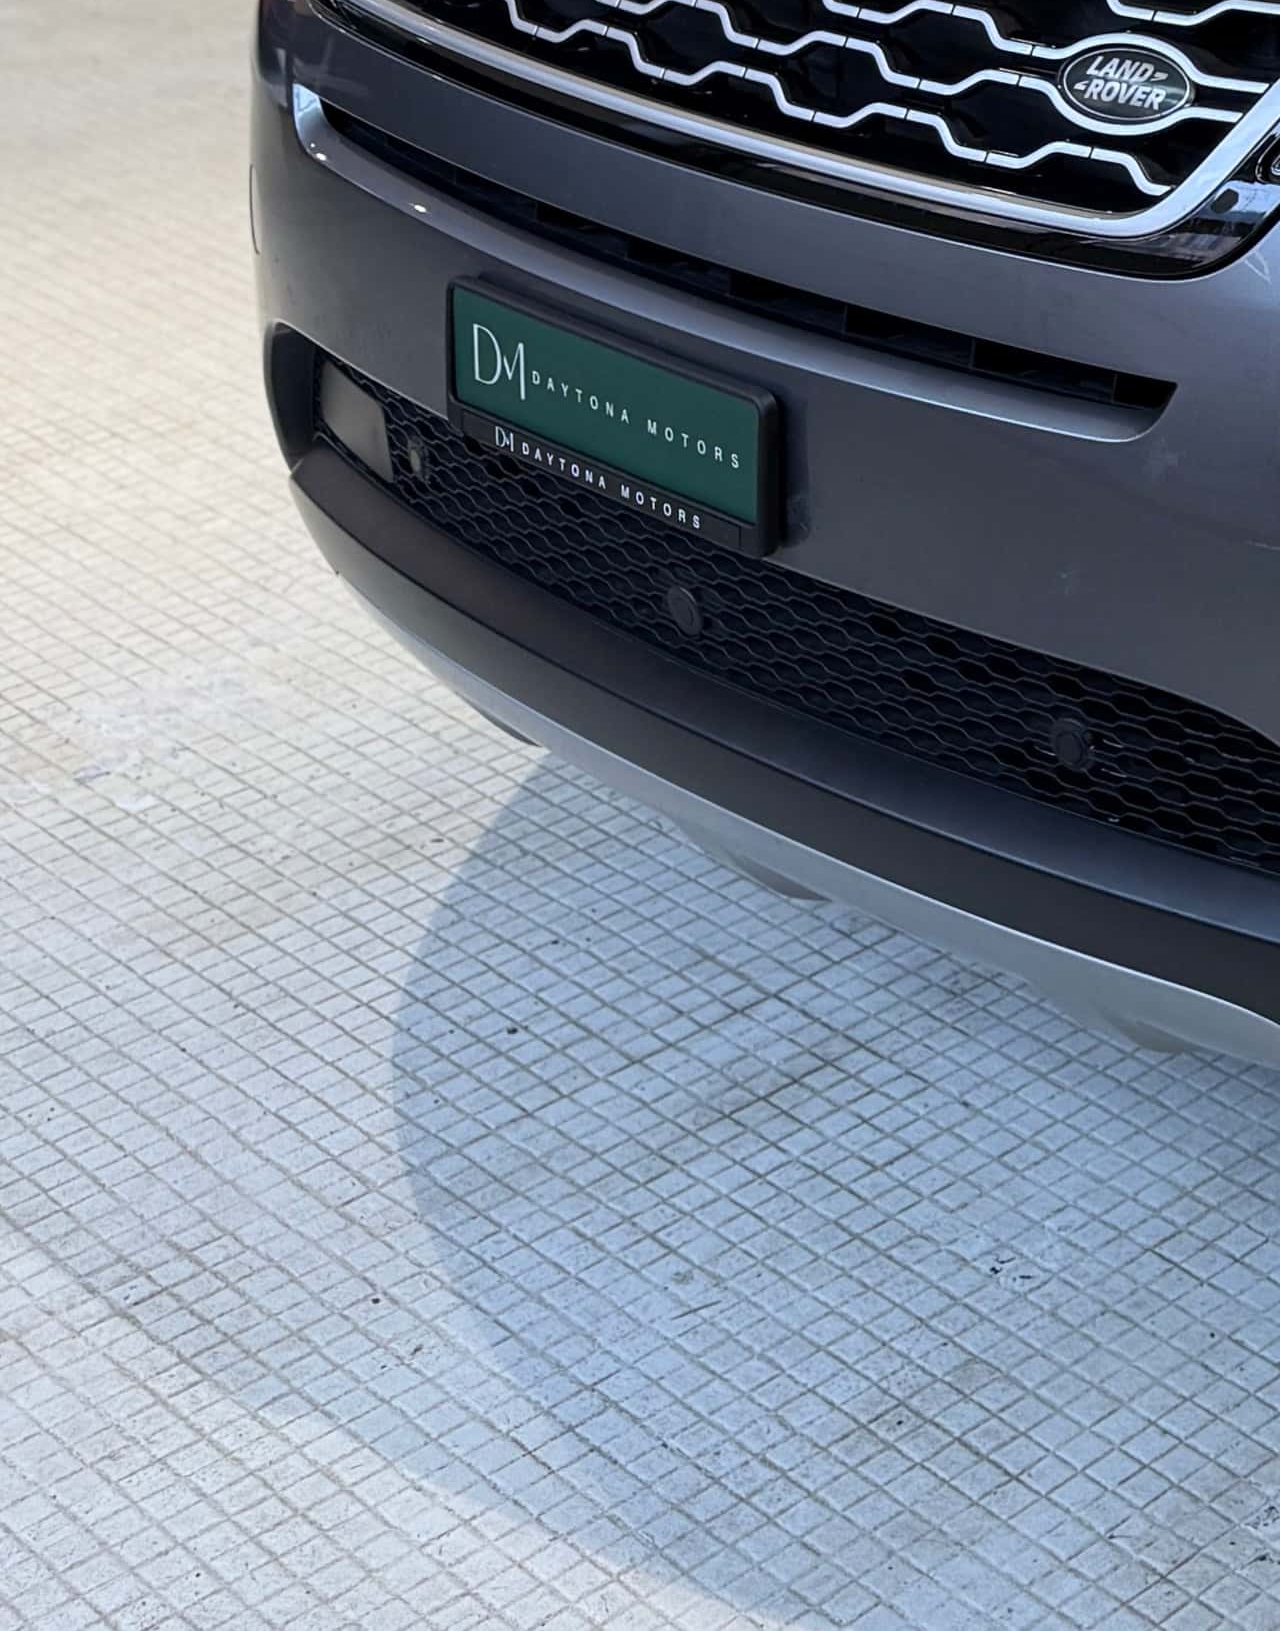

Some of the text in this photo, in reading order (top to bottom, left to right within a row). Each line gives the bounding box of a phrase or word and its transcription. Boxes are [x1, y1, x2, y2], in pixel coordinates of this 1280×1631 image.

[1083, 78, 1167, 111] ROVER
[1086, 55, 1155, 83] LAND
[531, 370, 630, 424] DAYTONA
[647, 419, 740, 469] MOTORS
[522, 441, 606, 490] DAYTONA
[620, 484, 701, 529] MOTORS
